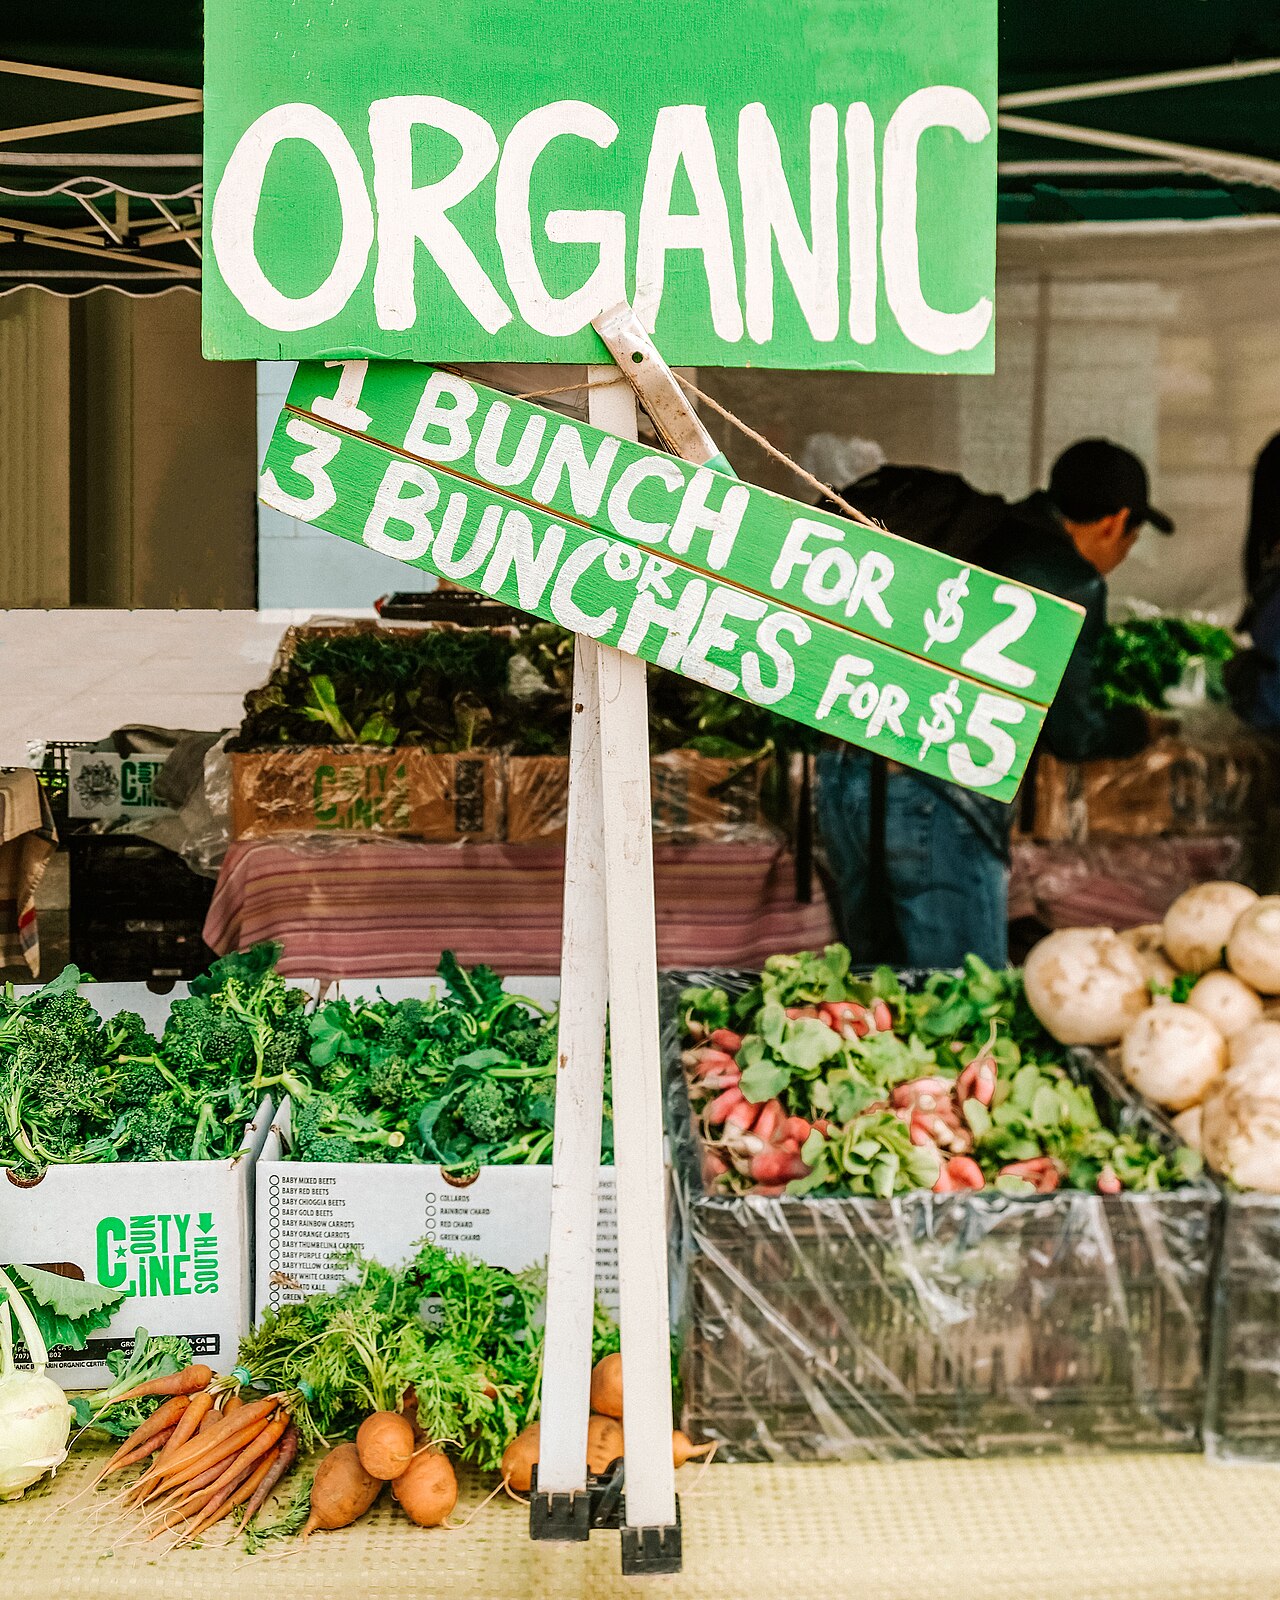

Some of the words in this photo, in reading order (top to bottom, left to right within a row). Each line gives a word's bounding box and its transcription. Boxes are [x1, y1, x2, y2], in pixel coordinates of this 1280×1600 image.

[211, 85, 994, 356] ORGANIC
[311, 360, 374, 432] 1
[403, 371, 750, 571] BUNCH
[770, 517, 896, 630] FOR
[603, 540, 678, 600] OR
[258, 418, 342, 522] 3
[362, 459, 812, 706] BUNCHES
[815, 653, 910, 739] FOR
[917, 679, 1027, 788] $5
[121, 761, 164, 800] COUNT
[282, 1176, 297, 1184] BABY
[312, 1188, 329, 1196] BEETS
[298, 1198, 326, 1206] CHIOGGIA
[440, 1194, 470, 1202] COLLARDS
[282, 1219, 297, 1227] BABY
[298, 1220, 327, 1228] RAINBOW
[298, 1230, 322, 1238] ORANGE
[324, 1231, 350, 1239] CARROTS
[96, 1214, 191, 1288] COUNTY
[299, 1241, 337, 1249] THUMBELINA
[194, 1236, 219, 1294] SOUTH
